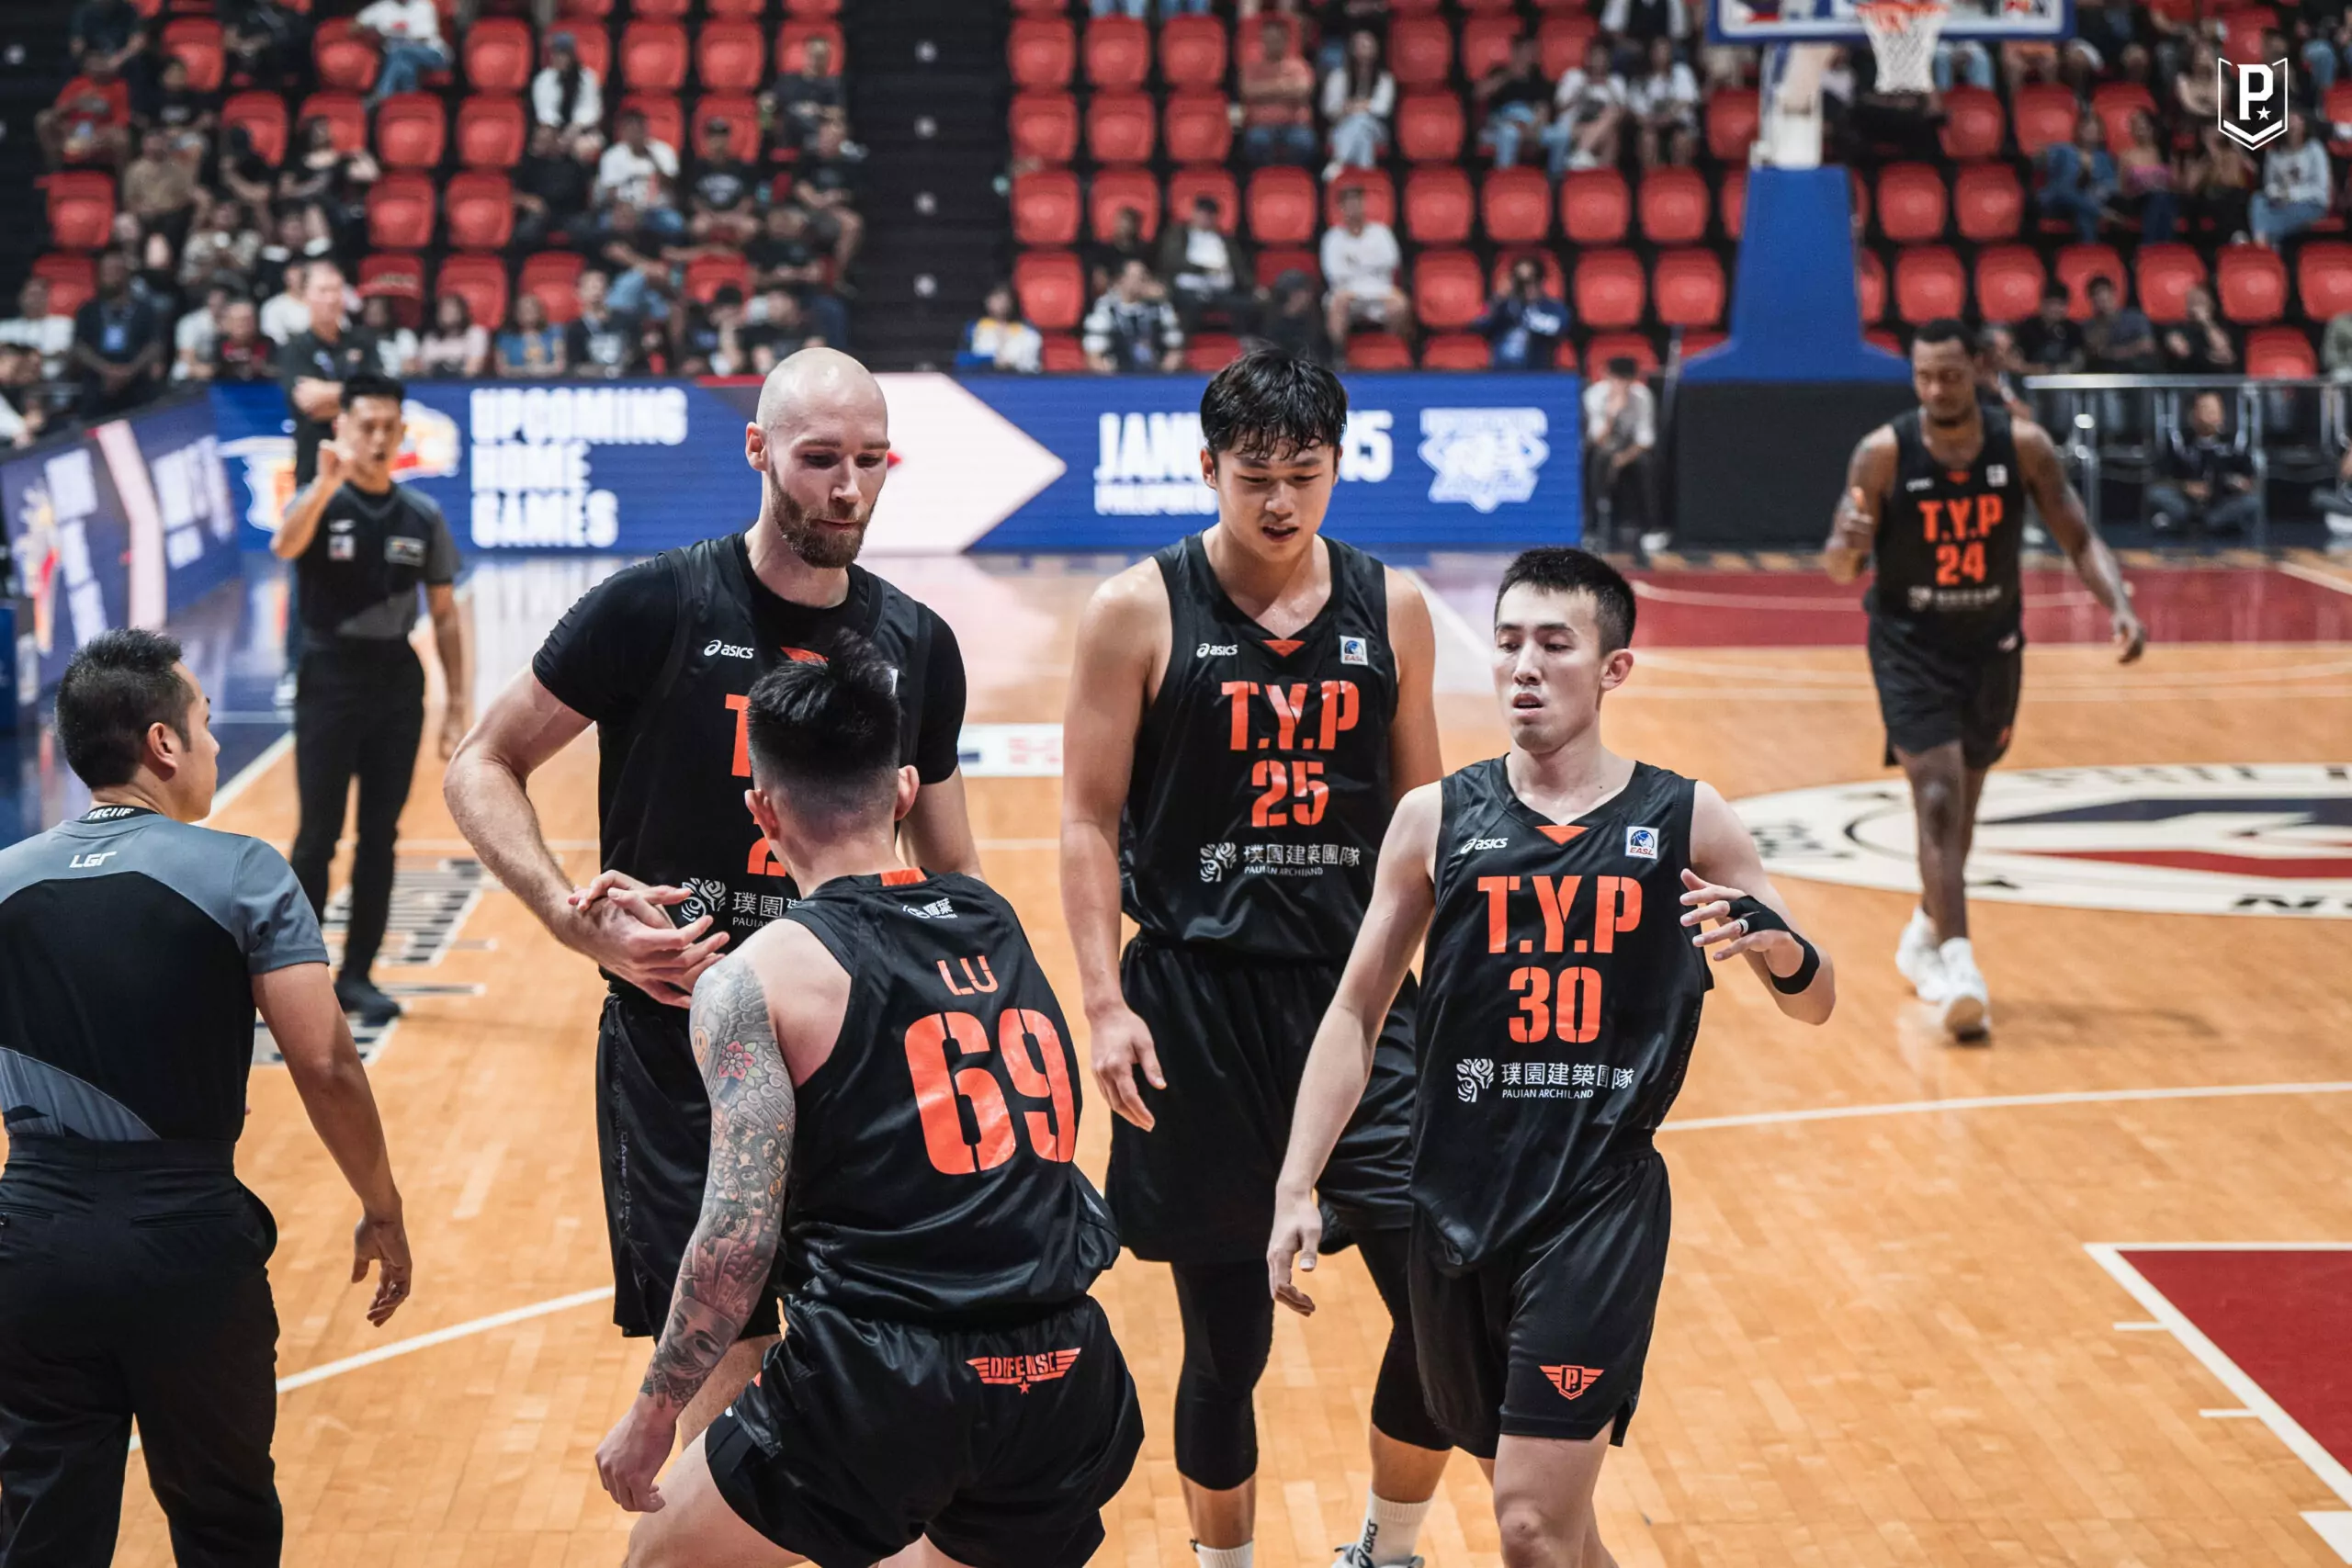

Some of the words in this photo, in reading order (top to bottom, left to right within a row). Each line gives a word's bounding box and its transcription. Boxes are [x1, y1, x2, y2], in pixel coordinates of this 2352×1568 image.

[469, 387, 687, 446] UPCOMING
[470, 441, 591, 491] HOME
[470, 489, 618, 548] GAMES
[1917, 493, 2003, 543] T.Y.P
[1936, 541, 1986, 586] 24
[720, 643, 754, 660] asics
[1210, 644, 1238, 657] asics
[1222, 680, 1360, 750] T.Y.P
[1251, 760, 1329, 828] 25
[1476, 836, 1509, 851] asics
[1629, 847, 1654, 856] EASL
[1476, 874, 1643, 954] T.Y.P
[937, 955, 999, 996] LU
[1509, 966, 1602, 1043] 30
[904, 1009, 1076, 1175] 69
[1501, 1089, 1537, 1099] PAUIAN
[1538, 1089, 1594, 1100] ARCHILAND
